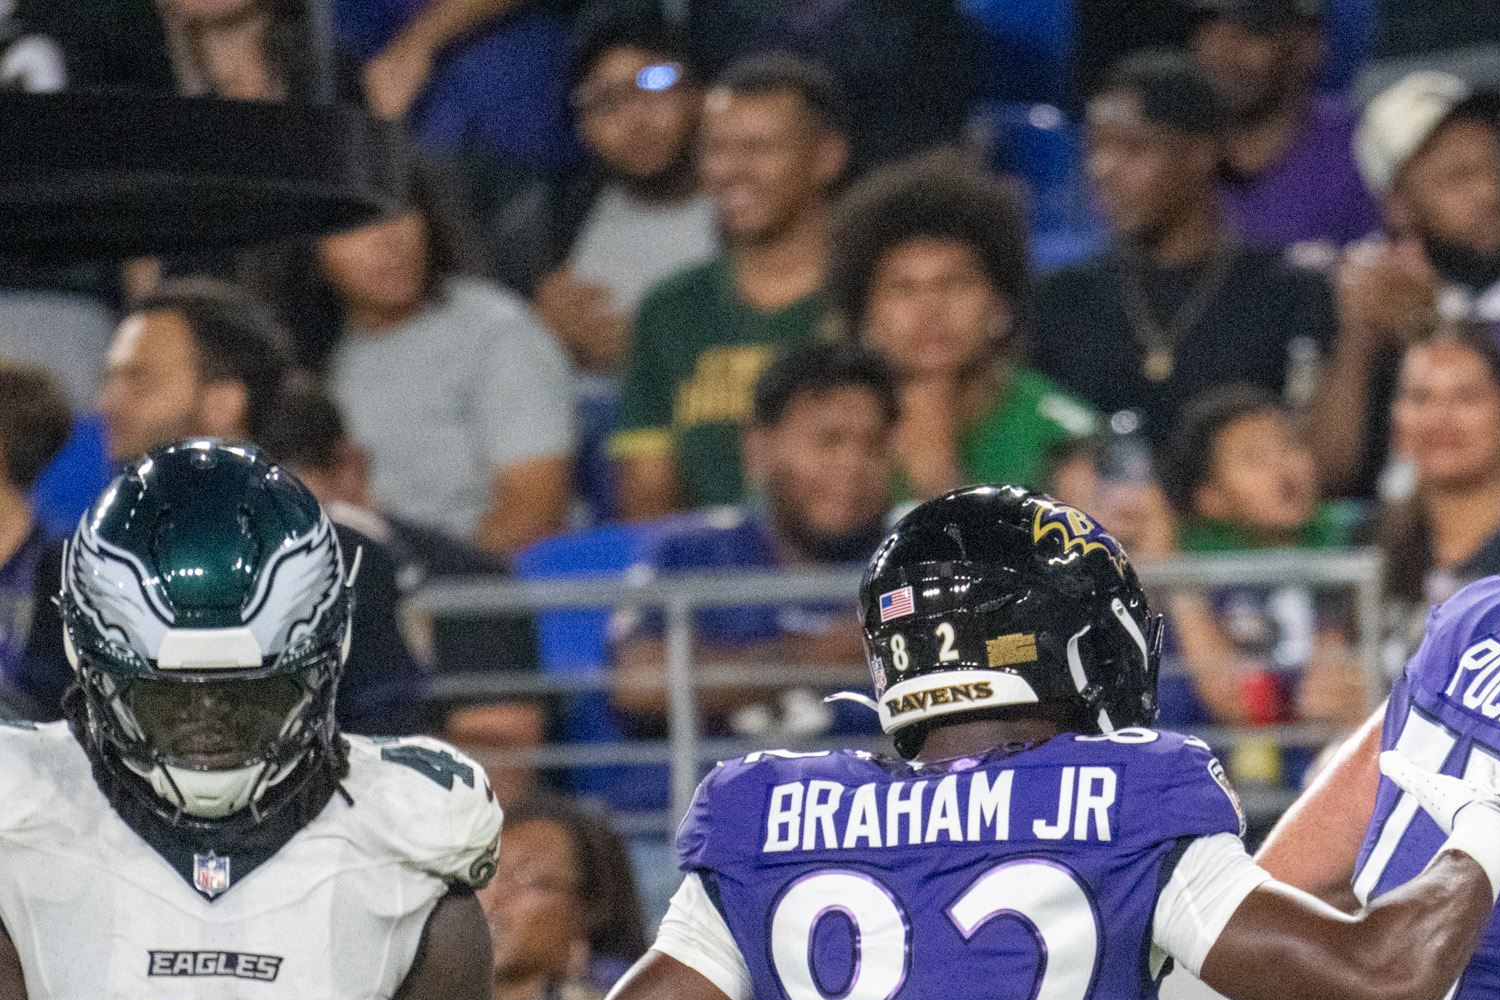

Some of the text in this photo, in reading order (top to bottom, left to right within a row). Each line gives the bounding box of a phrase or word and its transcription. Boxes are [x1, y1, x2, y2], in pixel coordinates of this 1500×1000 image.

[885, 681, 995, 718] RAVENS
[763, 766, 1118, 854] BRAHAM JR
[148, 950, 283, 983] EAGLES
